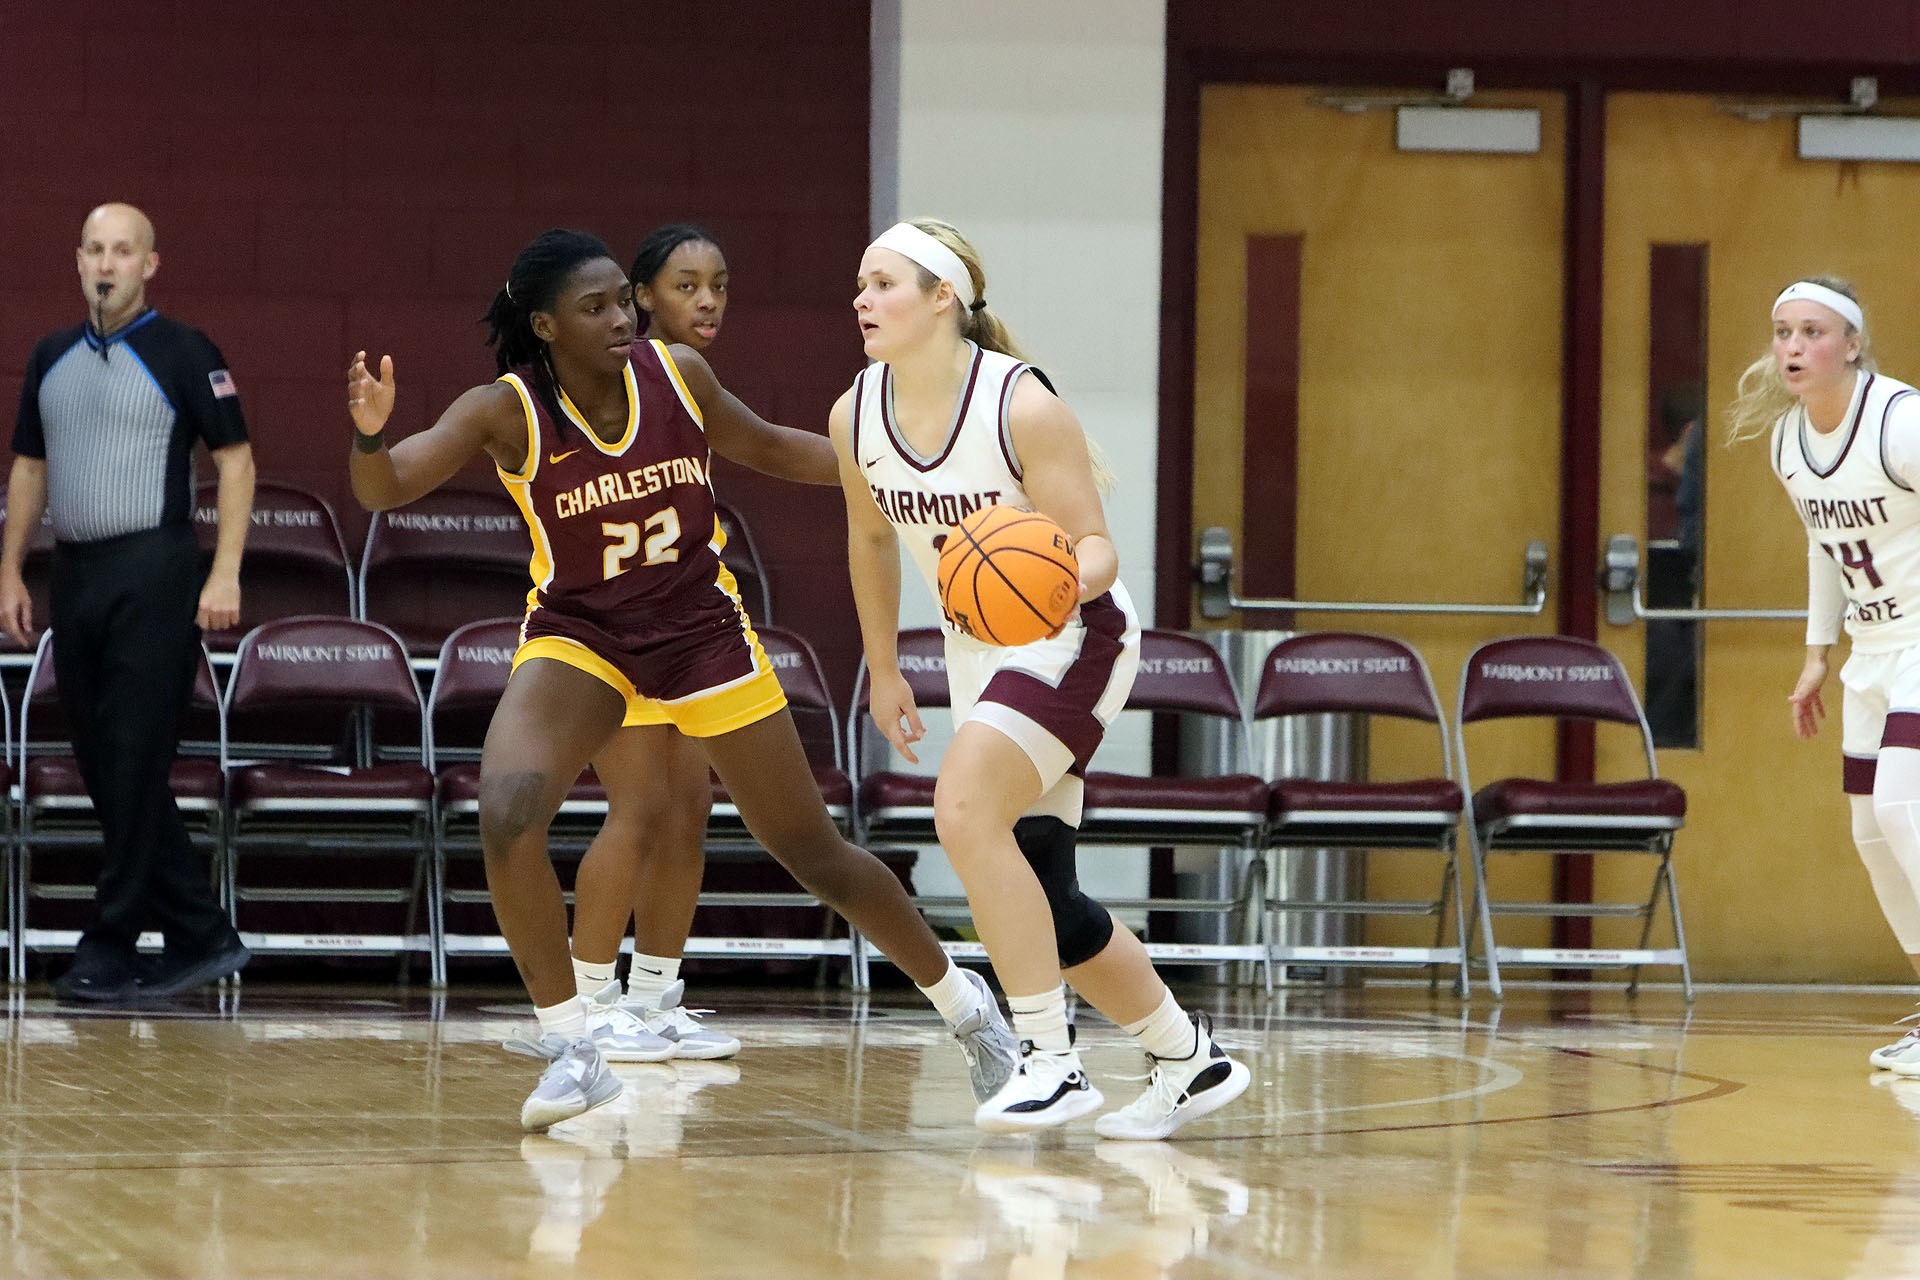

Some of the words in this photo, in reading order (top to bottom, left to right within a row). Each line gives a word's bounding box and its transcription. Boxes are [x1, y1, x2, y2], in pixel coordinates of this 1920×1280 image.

[555, 457, 706, 519] CHARLESTON
[273, 509, 321, 526] STATE
[387, 512, 470, 532] FAIRMONT
[473, 514, 521, 532] STATE
[601, 506, 682, 581] 22
[257, 644, 342, 664] FAIRMONT
[345, 643, 394, 662] STATE
[1165, 657, 1215, 675] STATE
[1274, 658, 1360, 675] FAIRMONT
[1362, 656, 1411, 674] STATE
[1481, 663, 1563, 682] FAIRMONT
[1567, 665, 1614, 682] STATE
